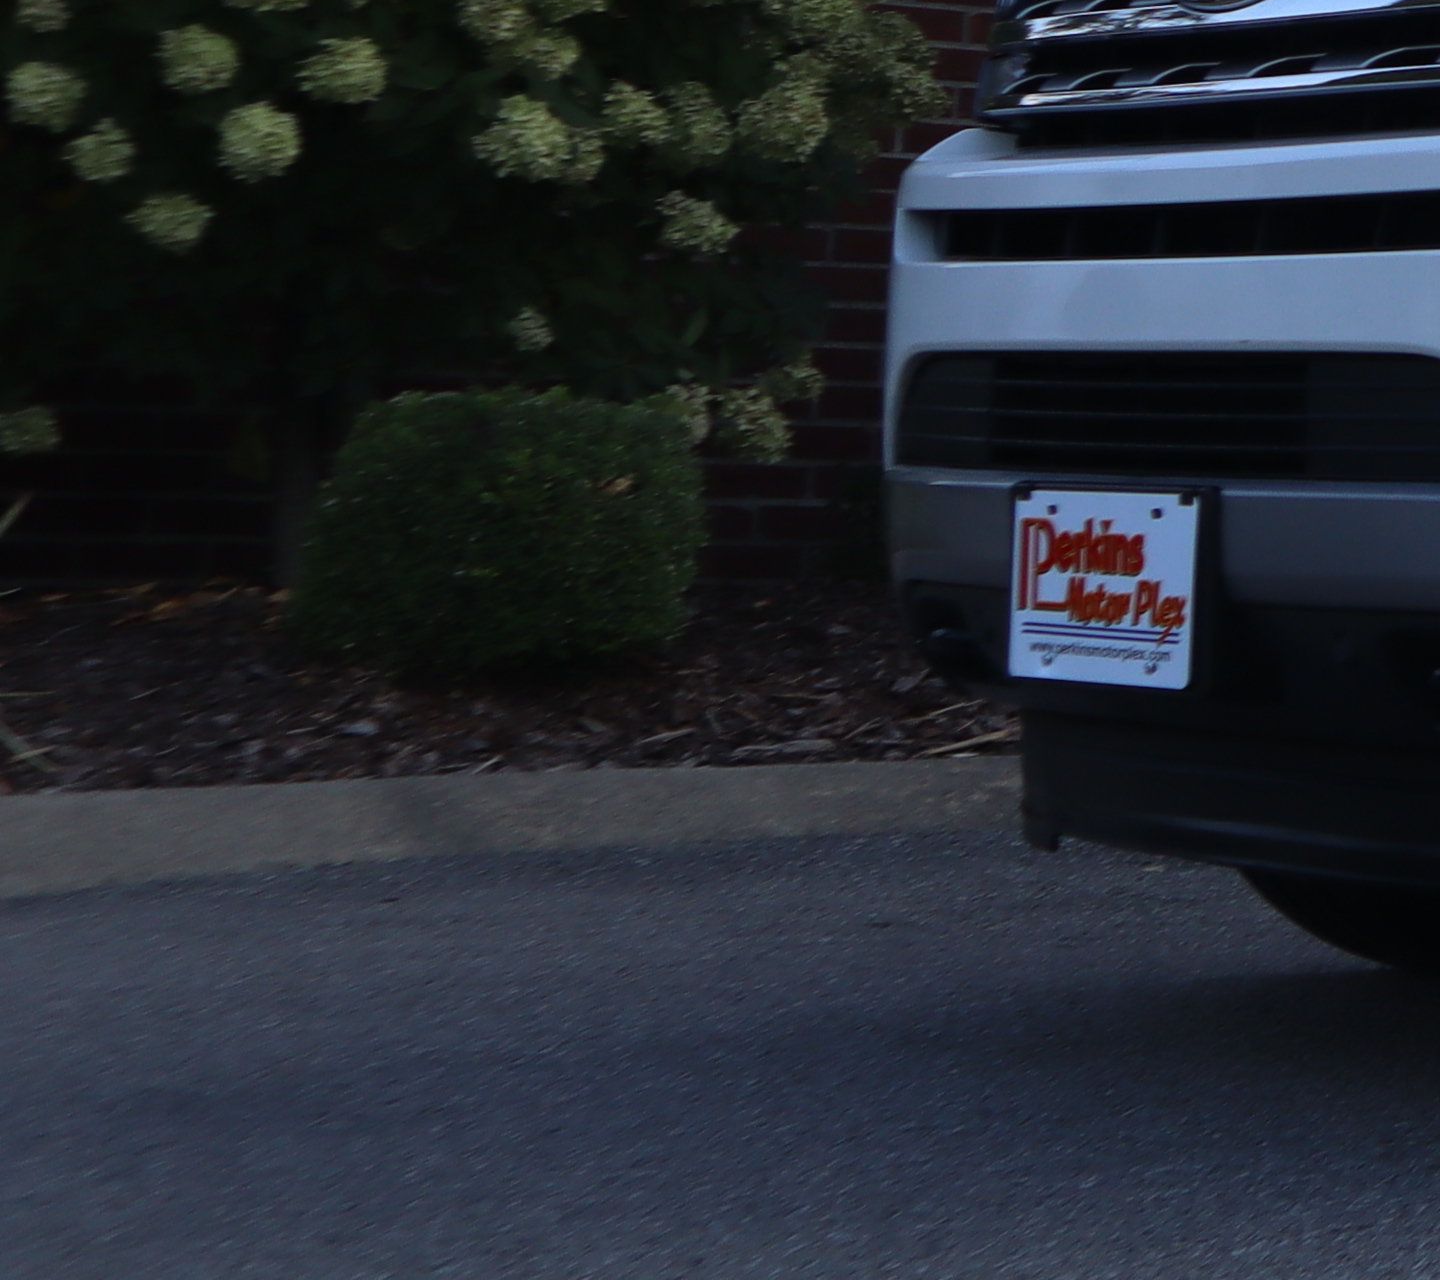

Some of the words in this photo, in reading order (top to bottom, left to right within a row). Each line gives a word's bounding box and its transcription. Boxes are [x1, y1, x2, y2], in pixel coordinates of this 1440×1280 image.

[1018, 517, 1145, 610] Perkins
[1068, 576, 1132, 626] Motor
[1131, 579, 1187, 646] Plex
